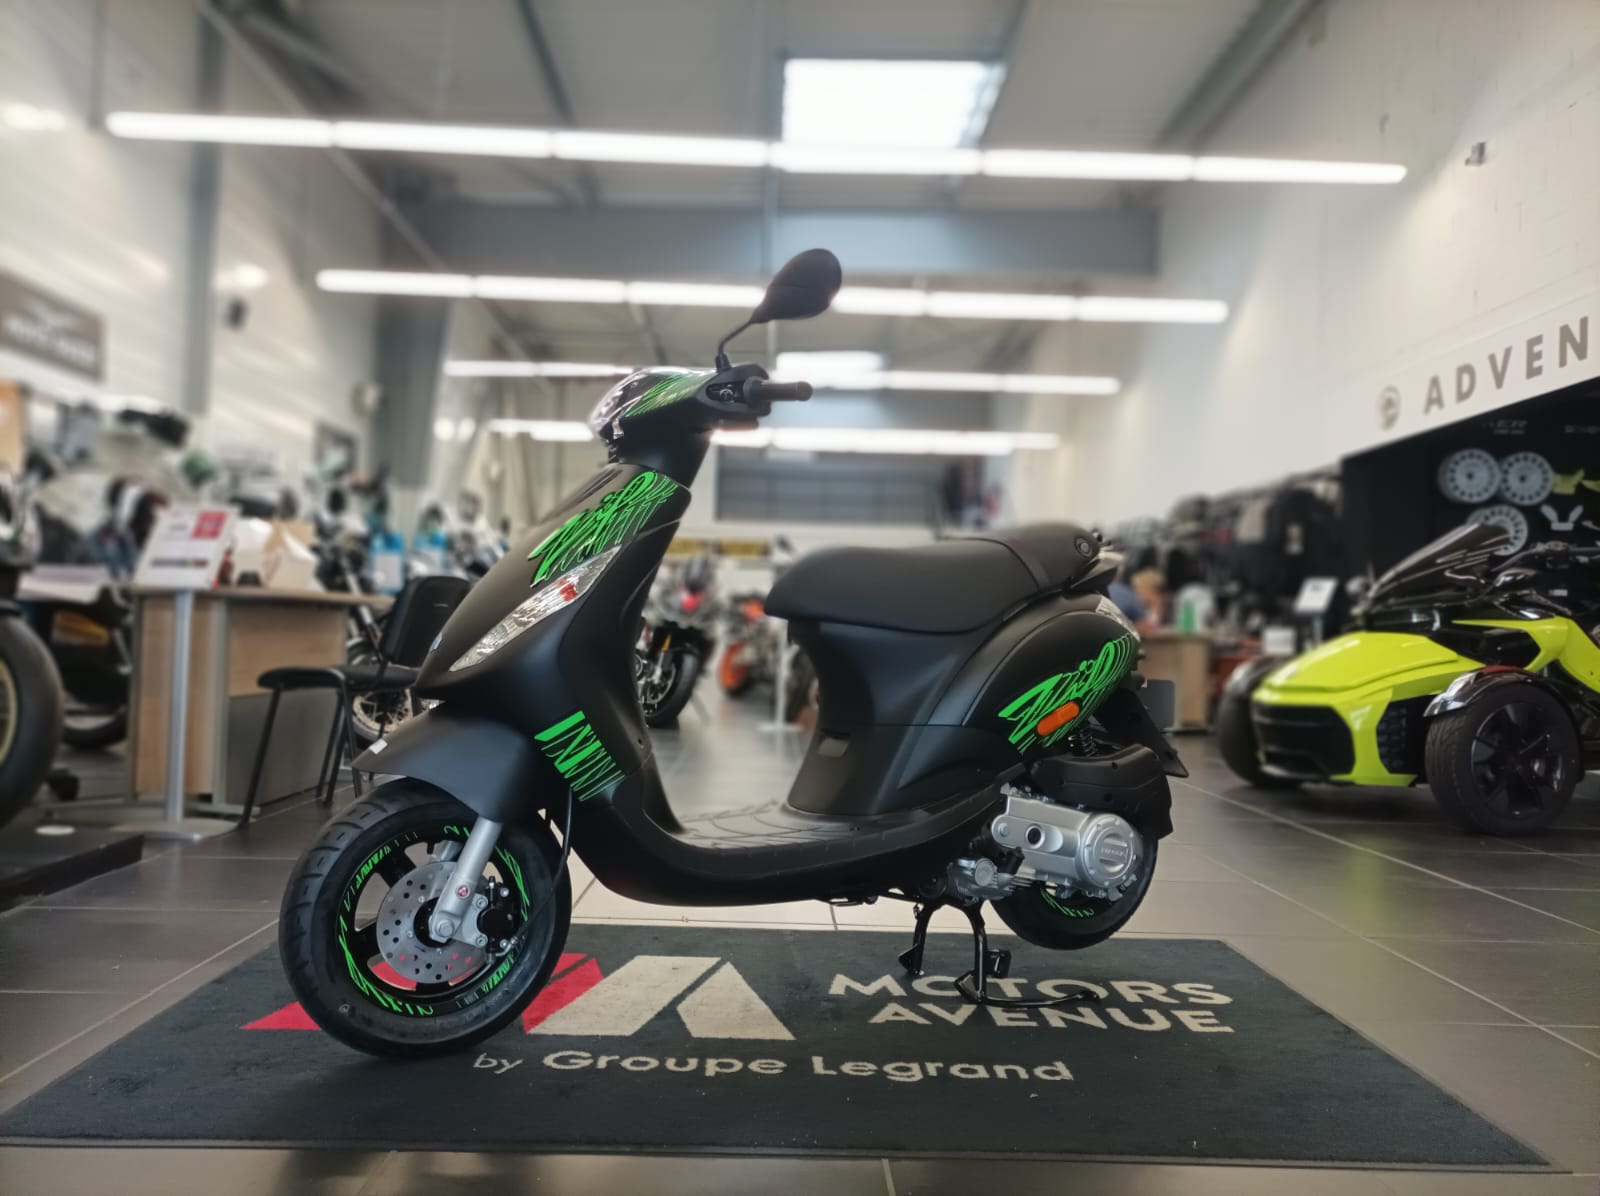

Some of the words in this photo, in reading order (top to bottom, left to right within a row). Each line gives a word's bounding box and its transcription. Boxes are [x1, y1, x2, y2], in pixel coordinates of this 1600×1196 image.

[828, 973, 1233, 1005] MOTORS
[868, 1002, 1235, 1033] AVENUE
[473, 1052, 523, 1074] by
[543, 1050, 787, 1077] Groupe
[811, 1056, 1074, 1082] Legrand
